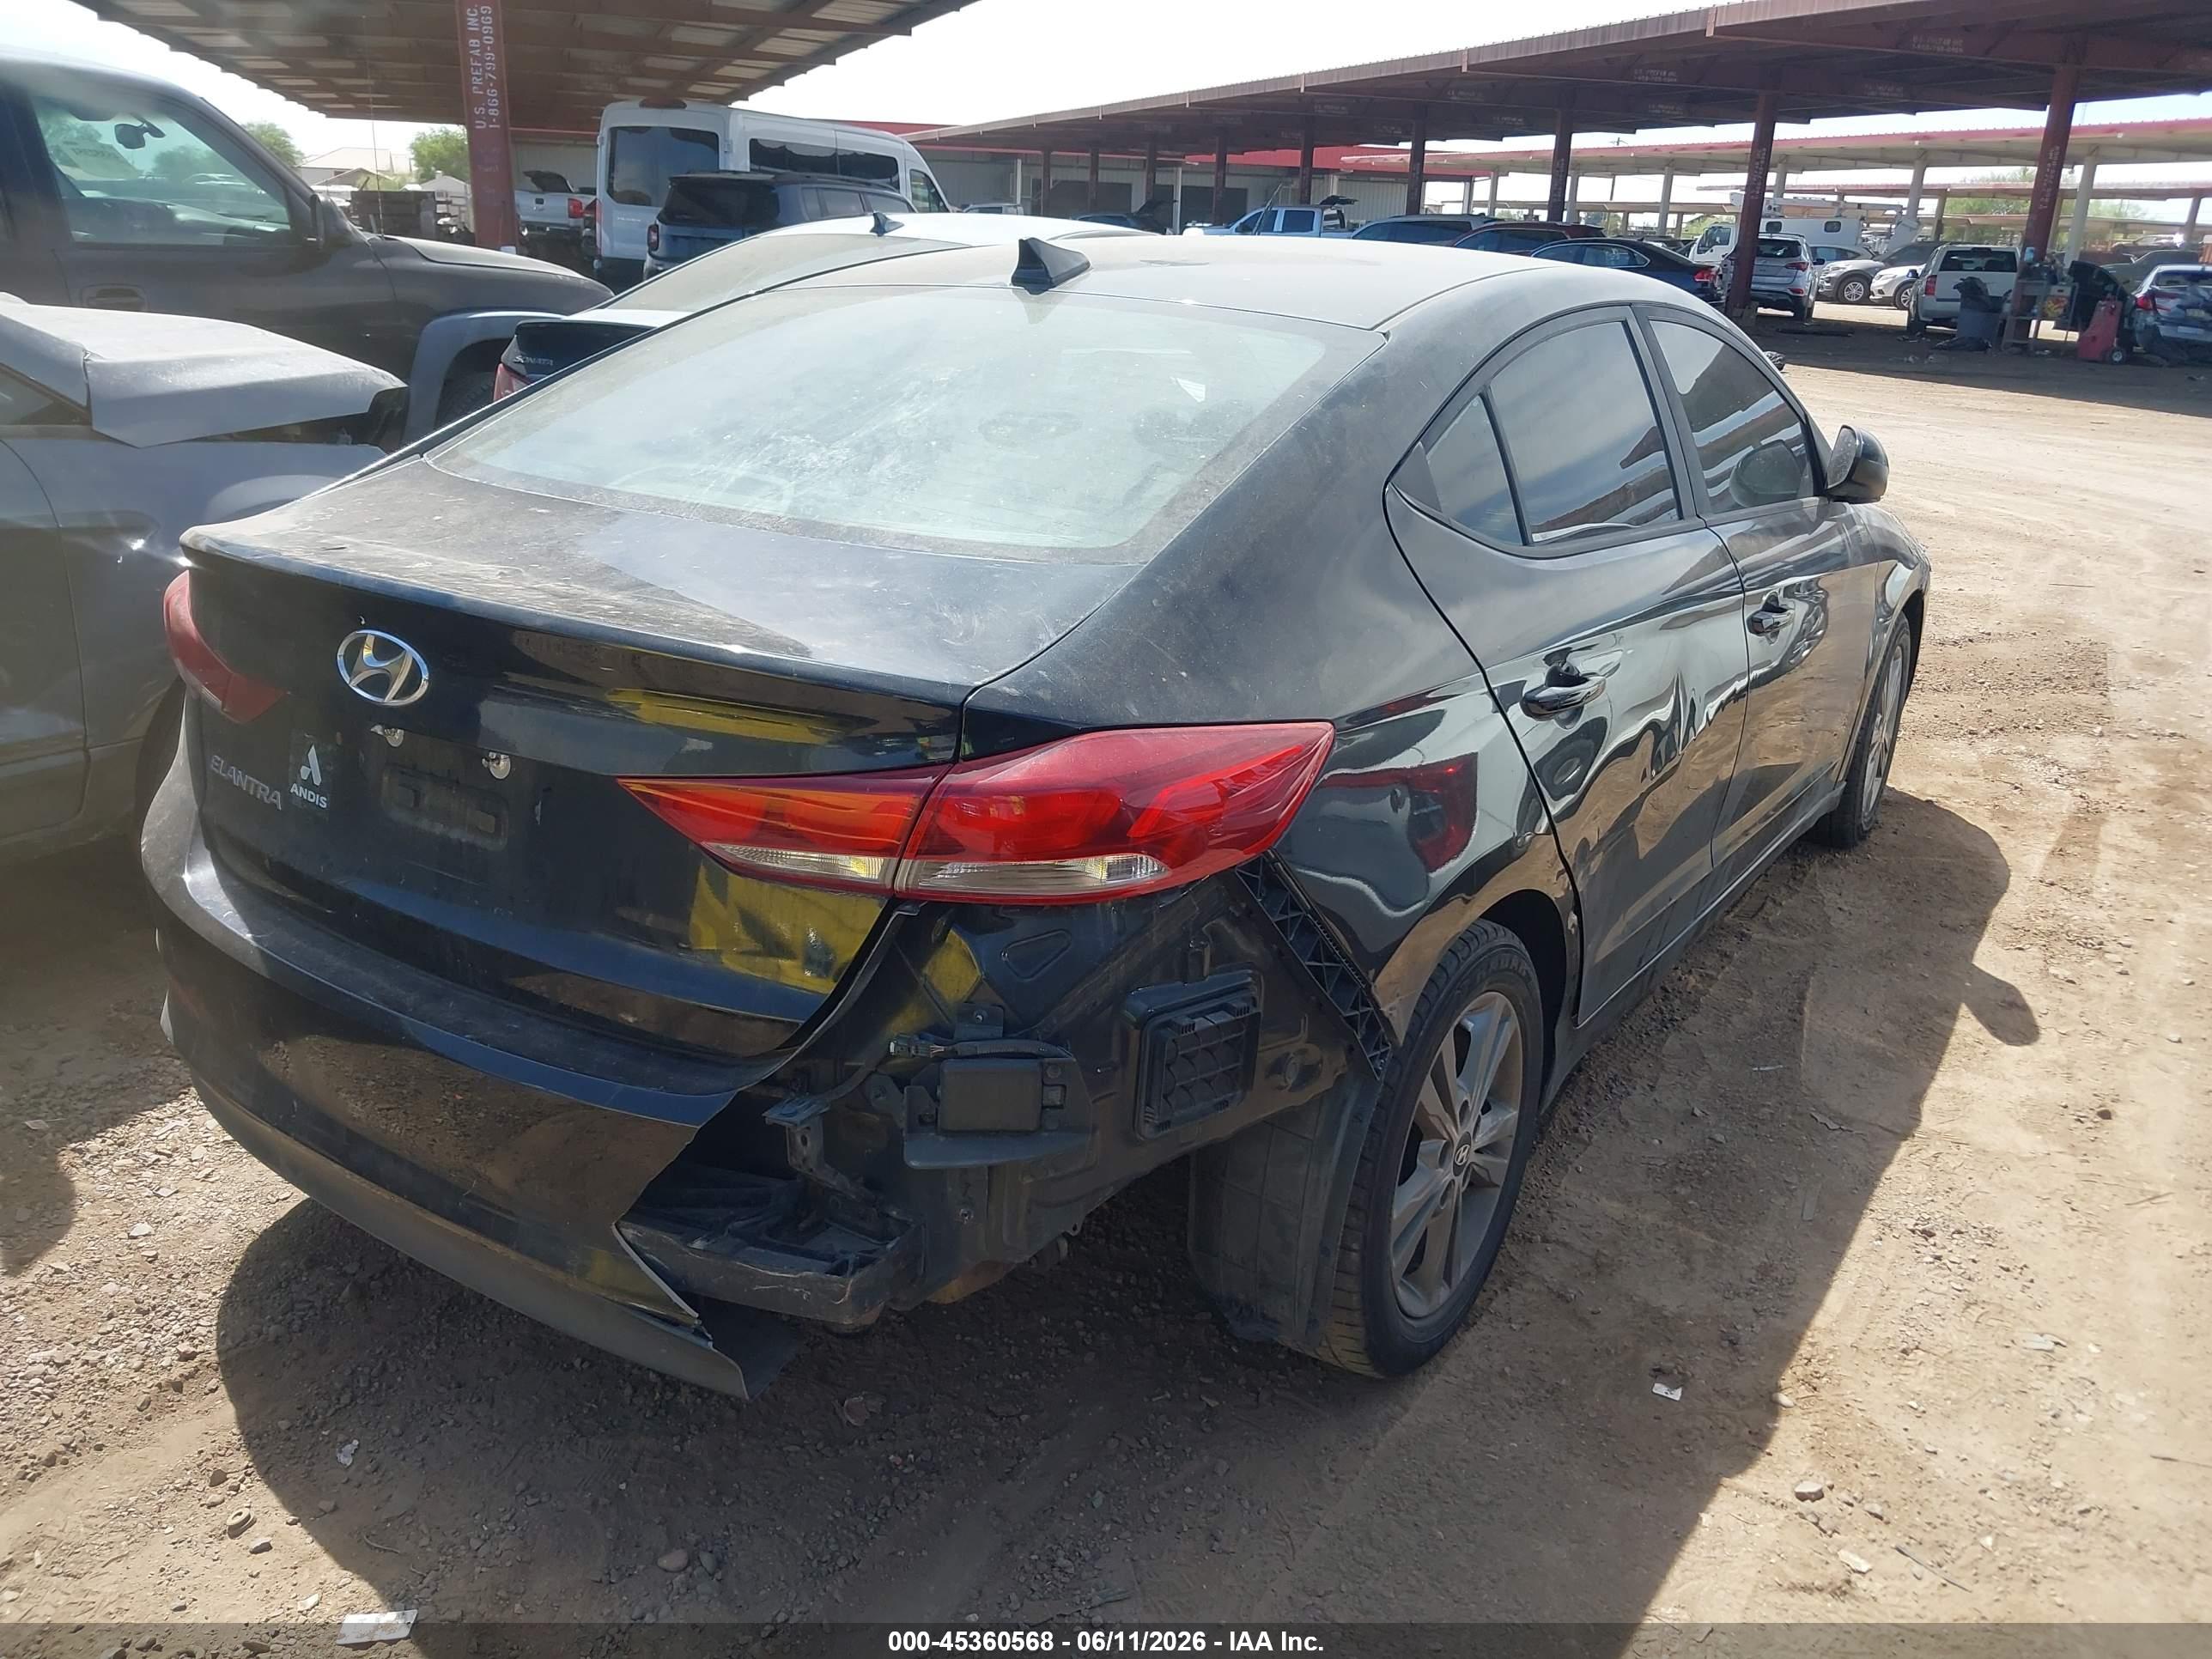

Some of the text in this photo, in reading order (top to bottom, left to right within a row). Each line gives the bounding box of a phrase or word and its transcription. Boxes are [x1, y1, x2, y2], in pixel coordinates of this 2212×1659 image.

[466, 4, 487, 129] U.S. PREFAB INC.
[480, 6, 501, 129] 1-866-799-0969
[211, 755, 282, 811] ELANTRA
[290, 782, 327, 808] ANDIS
